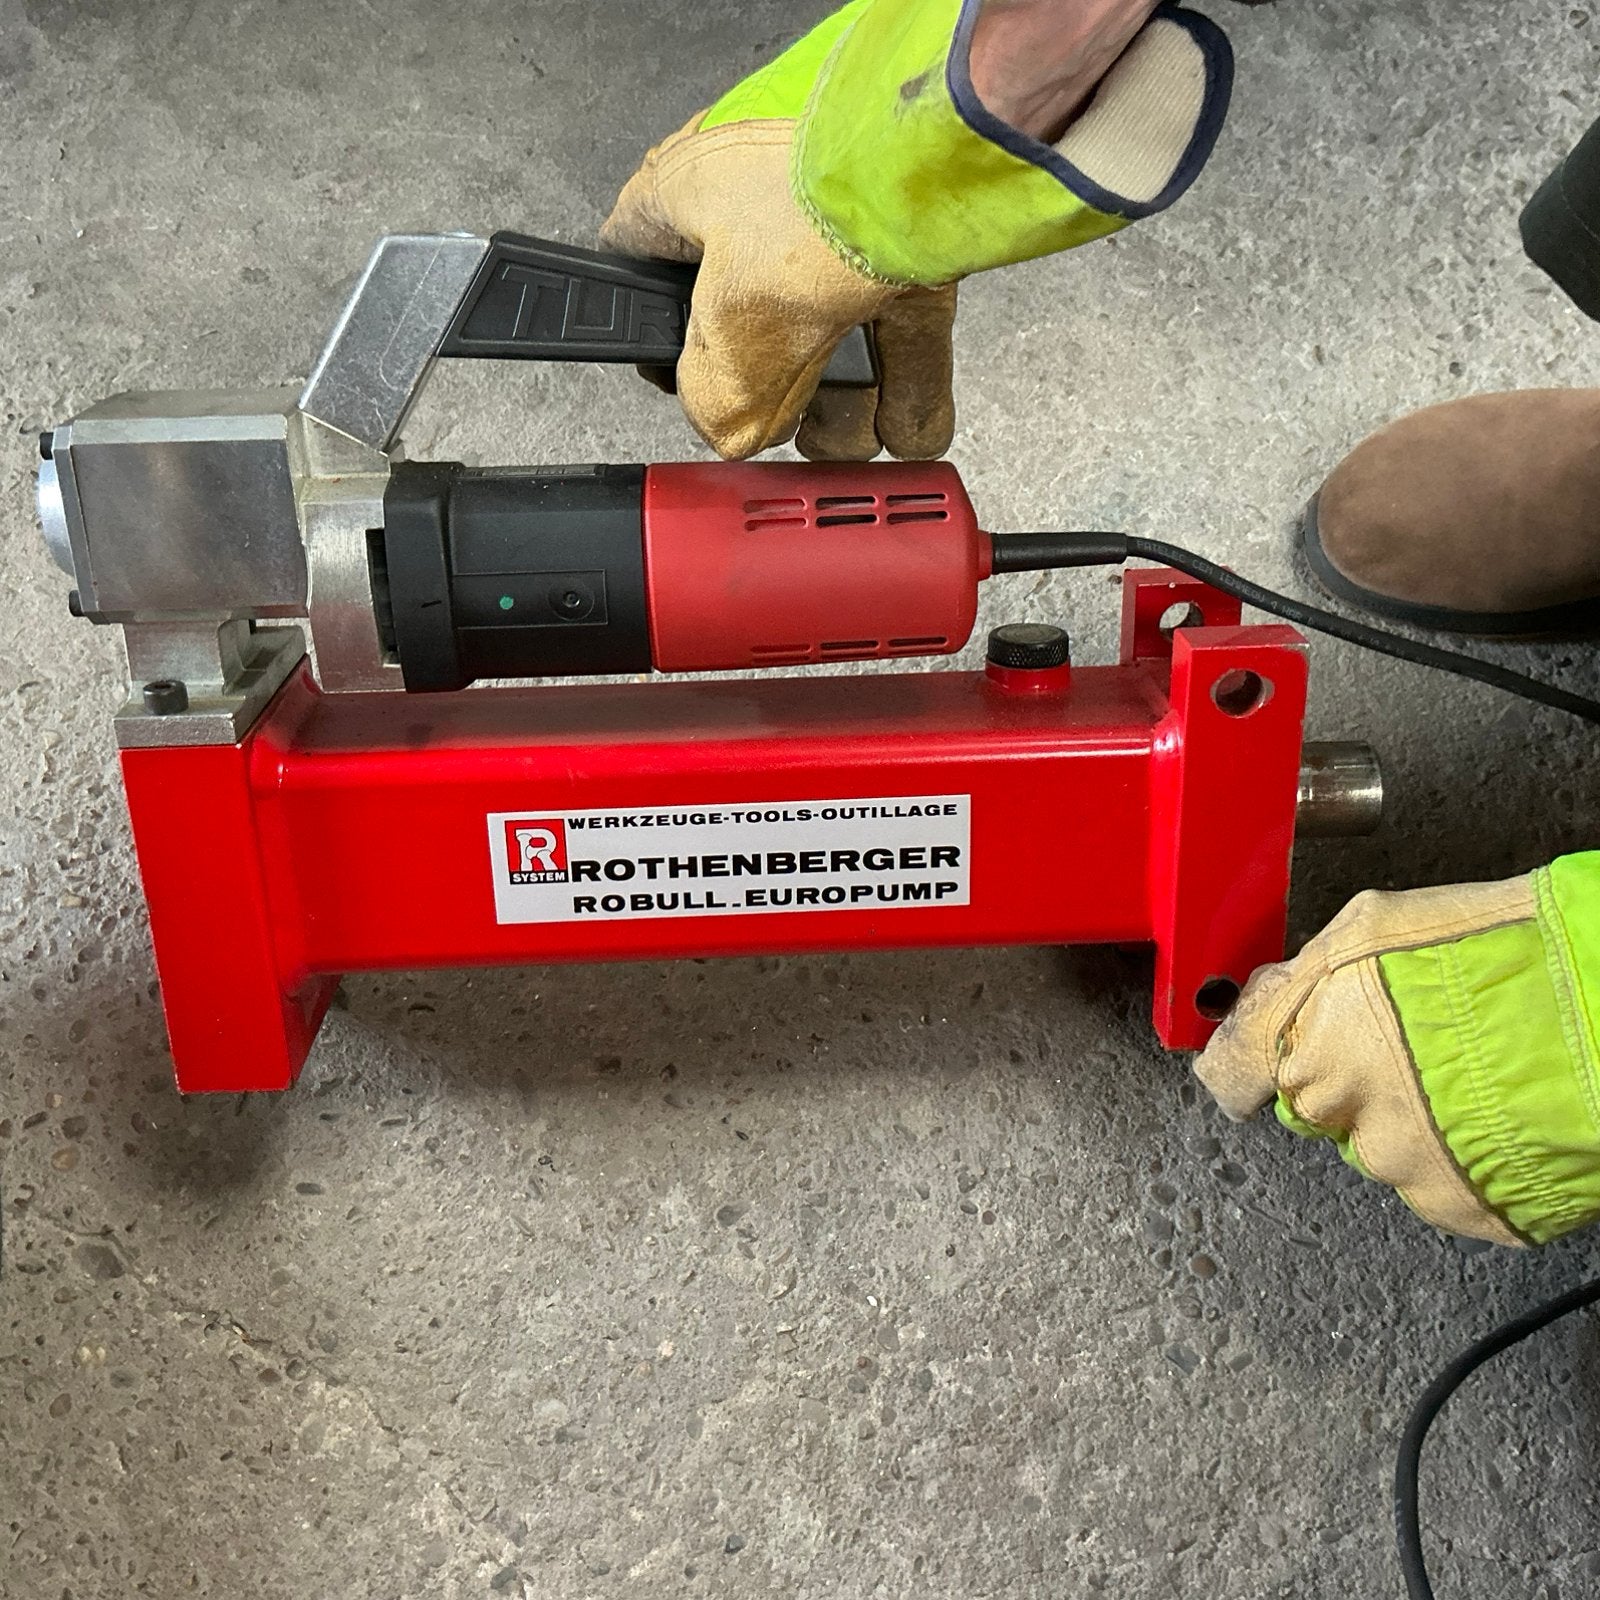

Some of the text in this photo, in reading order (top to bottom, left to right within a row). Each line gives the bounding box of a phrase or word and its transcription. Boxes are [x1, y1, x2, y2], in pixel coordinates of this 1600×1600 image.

[502, 263, 689, 344] TUR
[512, 872, 565, 883] SYSTEM
[571, 846, 960, 883] ROTHENBERGER
